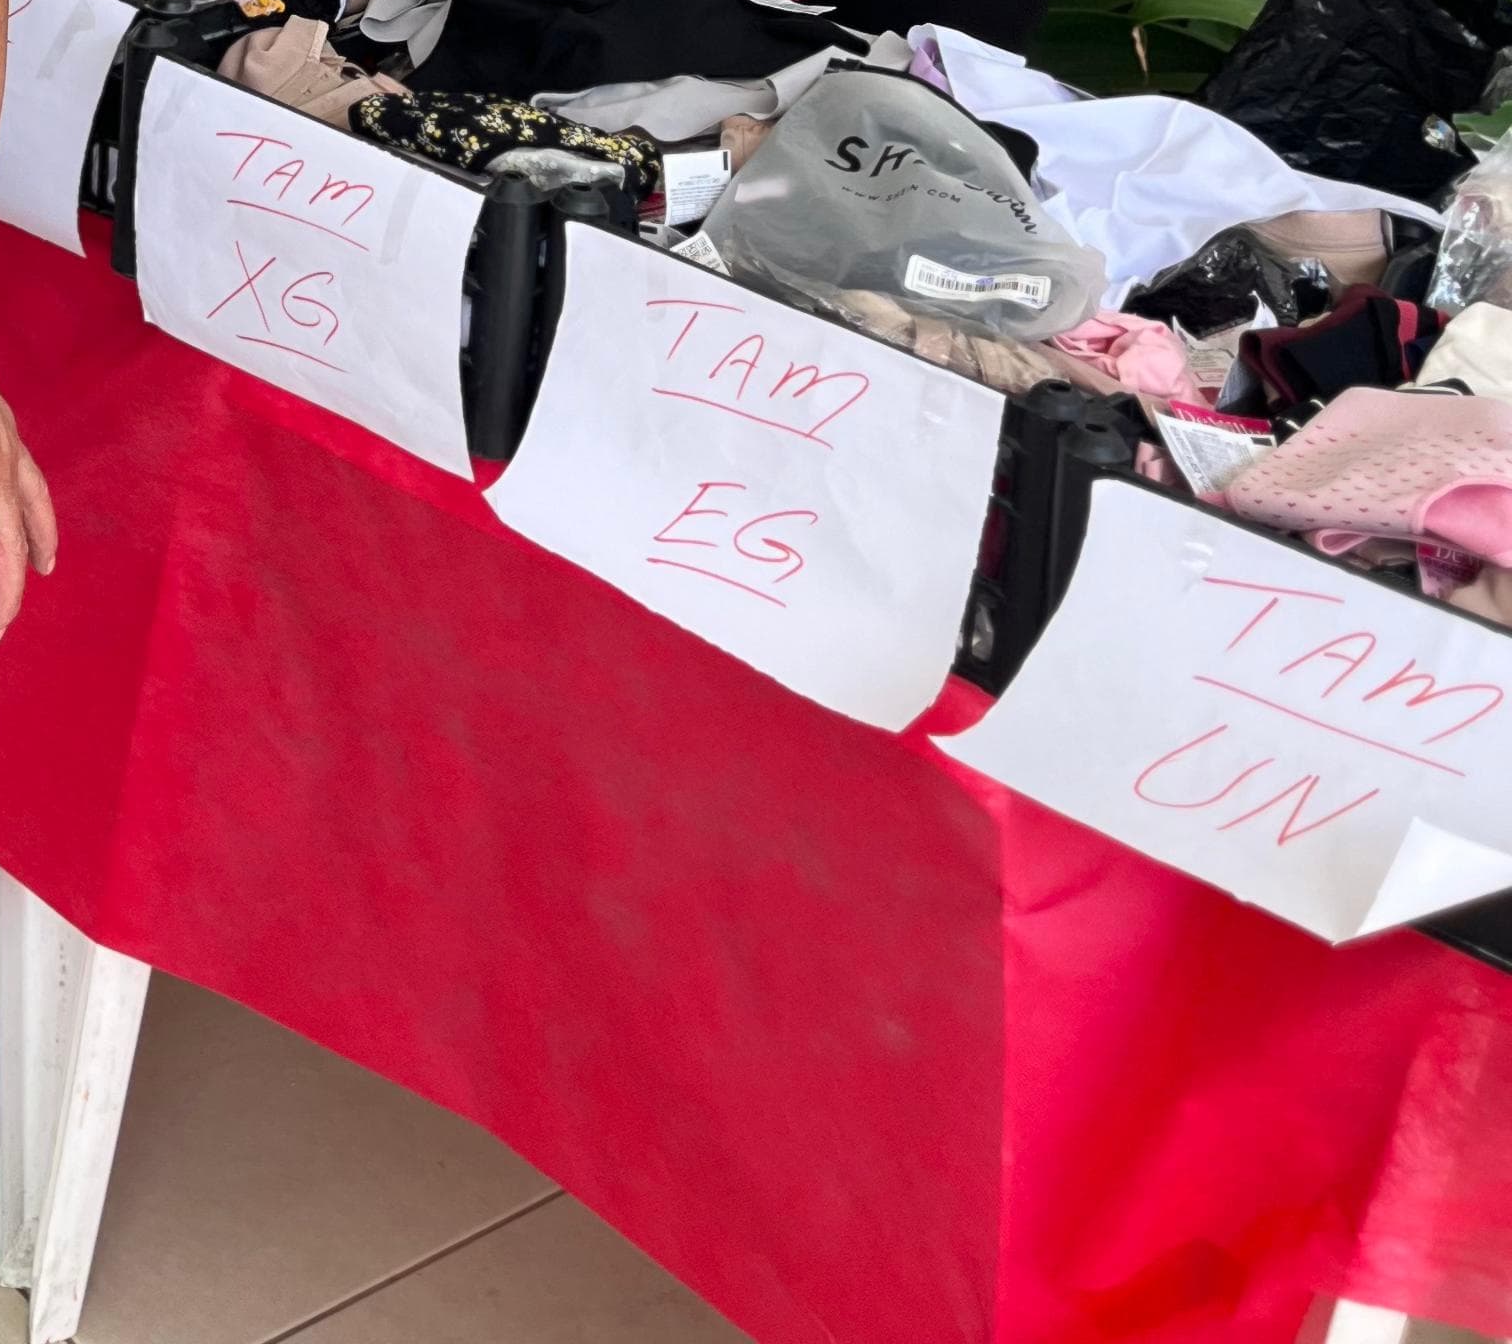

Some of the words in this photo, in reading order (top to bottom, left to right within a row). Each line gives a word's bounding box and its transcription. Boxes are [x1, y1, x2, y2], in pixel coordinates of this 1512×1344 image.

[206, 239, 340, 346] XG
[653, 481, 819, 584] EG
[1134, 723, 1381, 847] UN
